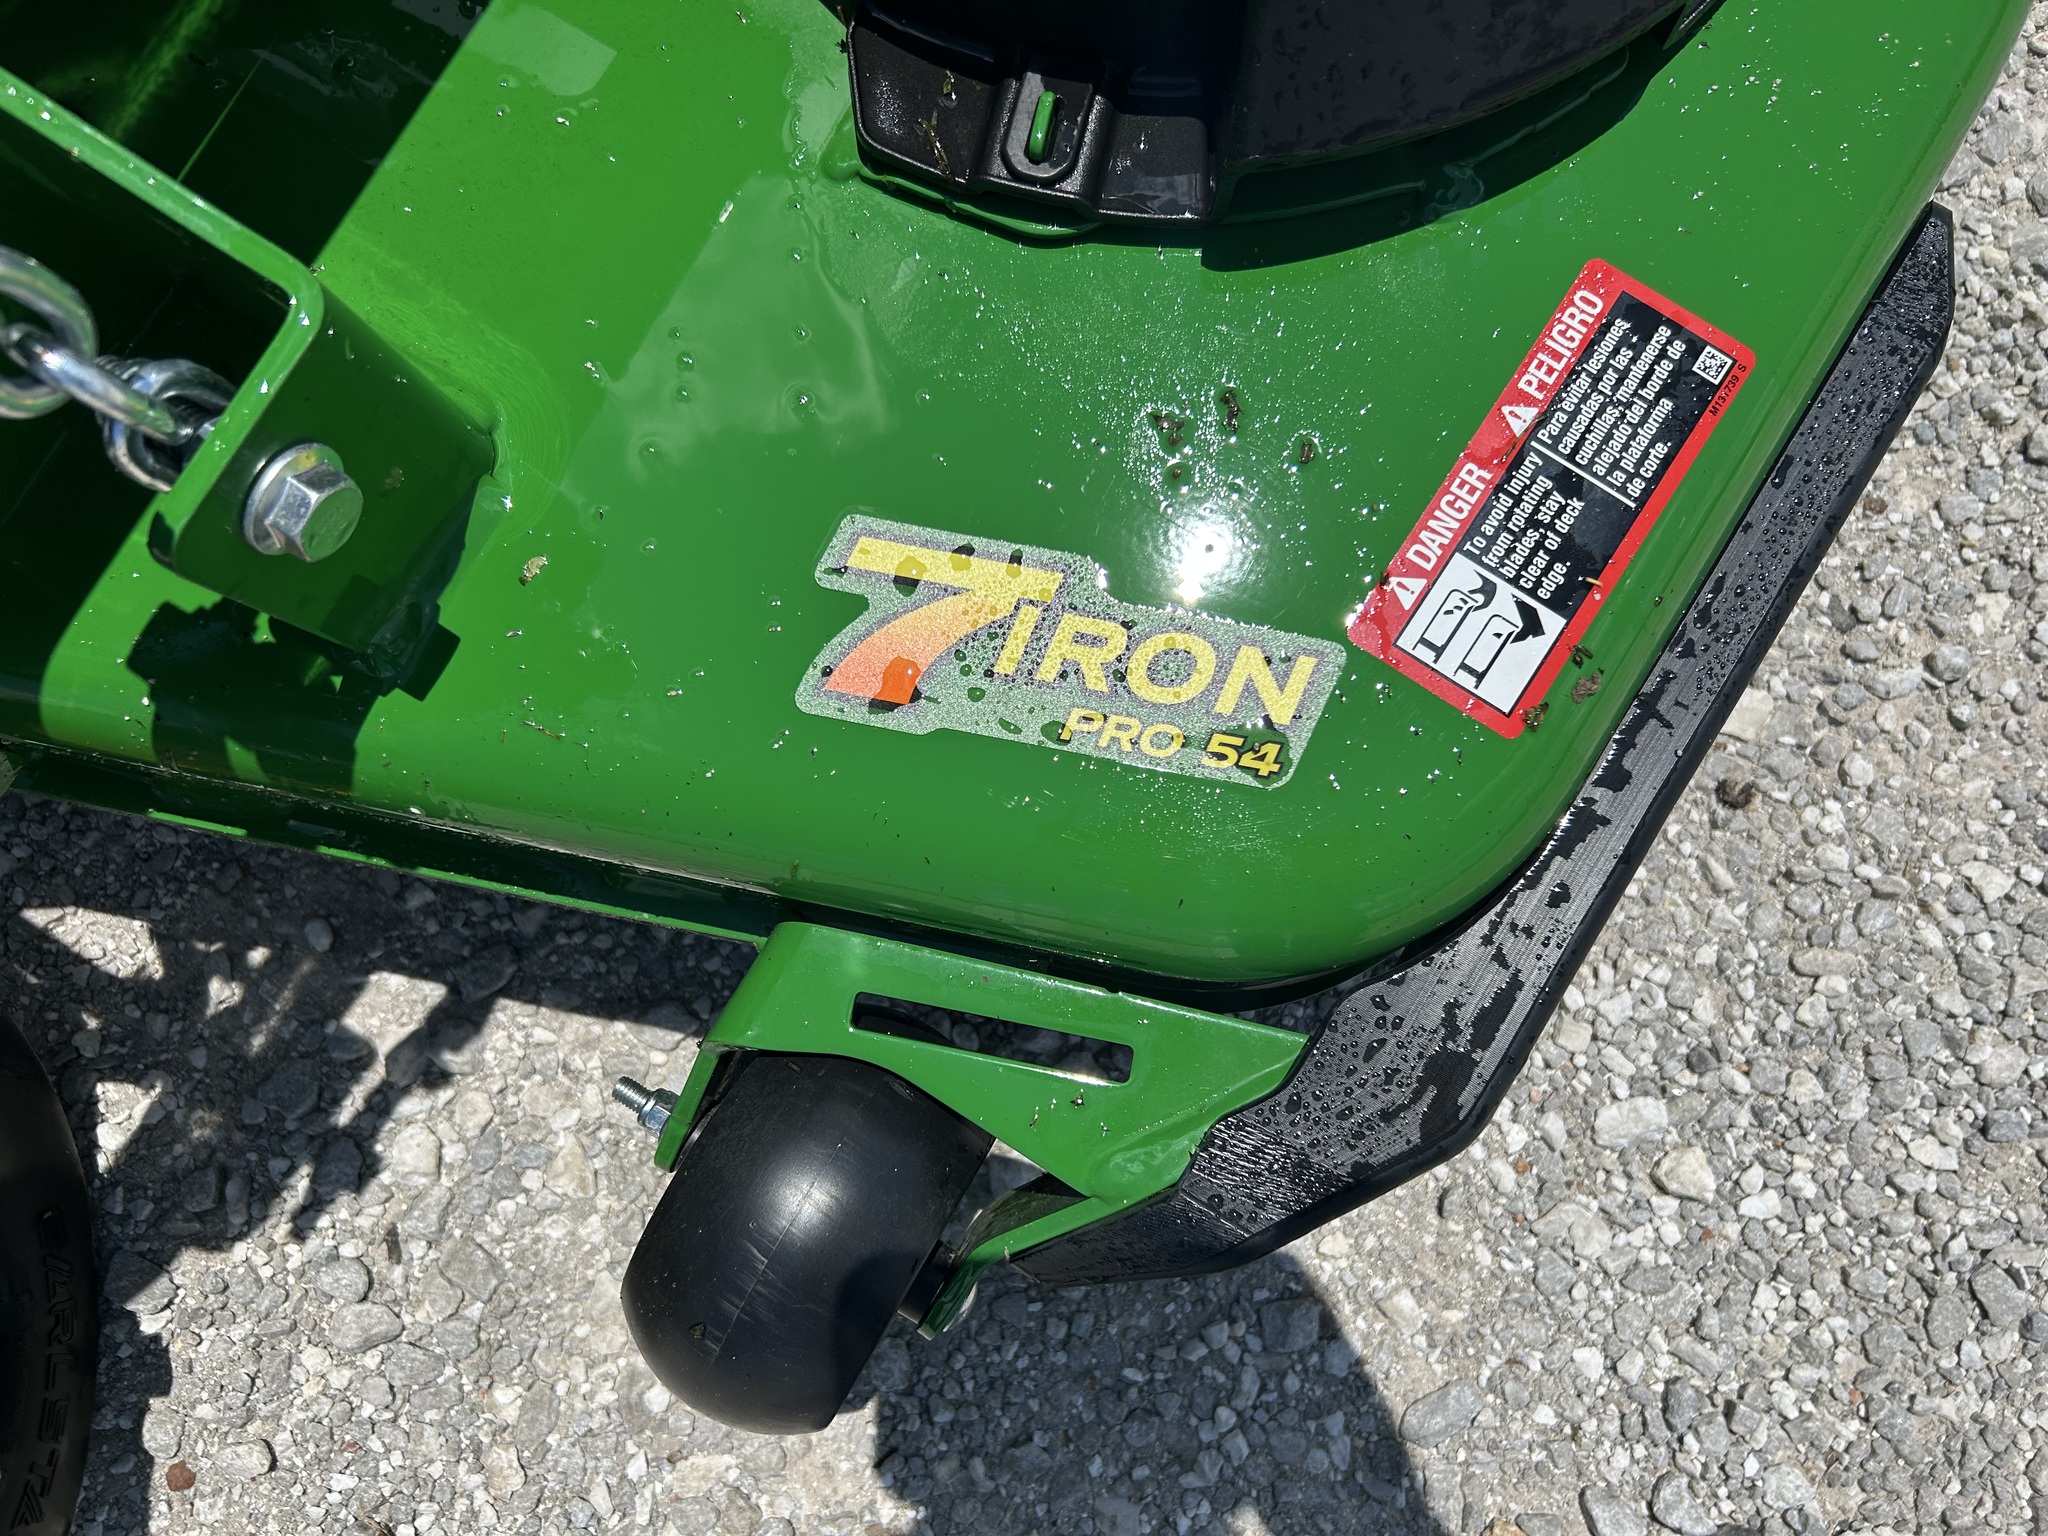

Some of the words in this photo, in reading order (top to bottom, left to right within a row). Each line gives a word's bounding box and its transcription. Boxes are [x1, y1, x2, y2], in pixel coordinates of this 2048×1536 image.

[1518, 290, 1603, 400] PELIGRO
[1537, 411, 1568, 444] Para
[1562, 371, 1593, 412] evitar
[1582, 318, 1626, 374] lesiones
[1737, 363, 1747, 372] S
[1558, 392, 1604, 454] causadas
[1597, 367, 1619, 396] por
[1609, 347, 1633, 370] las
[1575, 405, 1624, 465] cuchillas,
[1615, 325, 1671, 402] mantenerse
[1592, 423, 1632, 476] alejado
[1625, 397, 1648, 424] del
[1638, 359, 1674, 400] borde
[1666, 340, 1686, 360] de
[1606, 470, 1627, 487] la
[1620, 398, 1674, 473] plataforma
[1626, 477, 1646, 498] de
[1640, 441, 1672, 478] corte.
[1405, 462, 1493, 571] DANGER
[1463, 536, 1486, 555] To
[1481, 493, 1514, 536] avoid
[1504, 451, 1543, 495] injury
[1482, 532, 1514, 568] from
[1507, 475, 1553, 532] rotating
[1499, 527, 1546, 579] blades,
[1537, 491, 1567, 524] stay
[1519, 550, 1550, 589] clear
[1544, 530, 1562, 550] of
[1553, 497, 1585, 534] deck
[1536, 561, 1571, 600] edge.
[1059, 707, 1184, 758] PRO
[1200, 732, 1284, 777] 54
